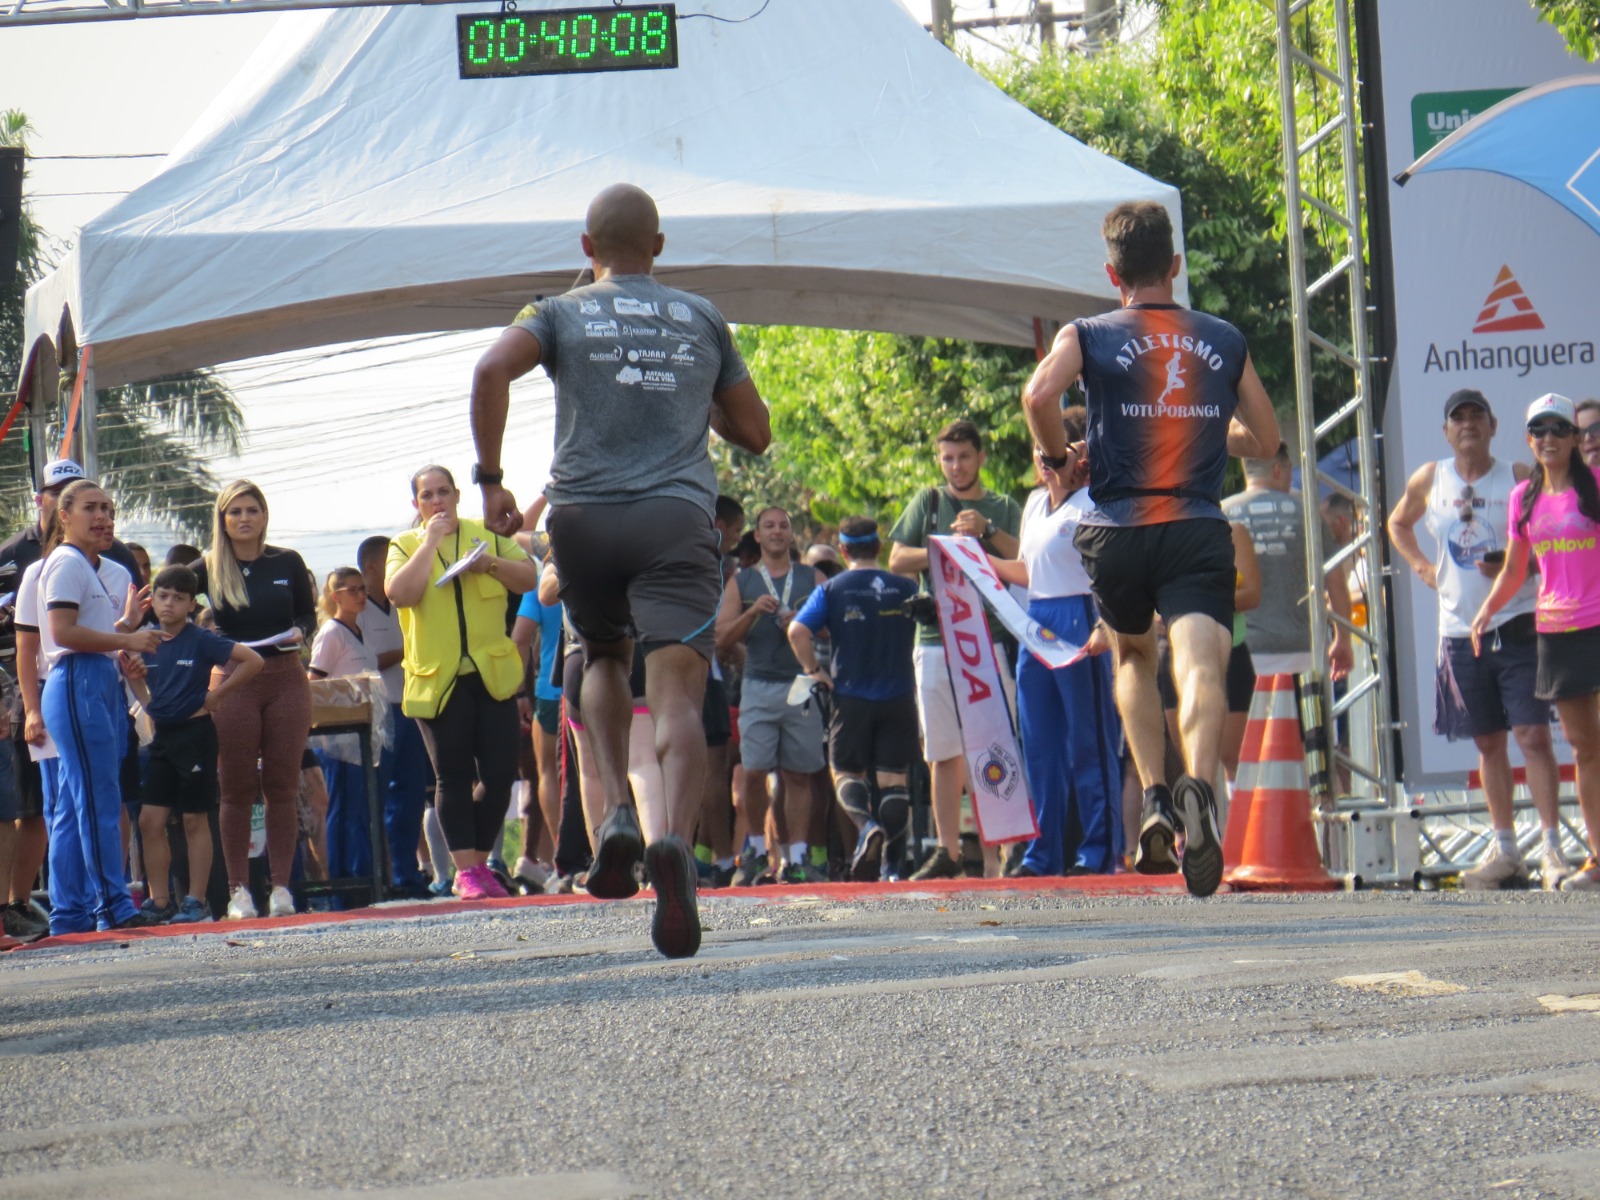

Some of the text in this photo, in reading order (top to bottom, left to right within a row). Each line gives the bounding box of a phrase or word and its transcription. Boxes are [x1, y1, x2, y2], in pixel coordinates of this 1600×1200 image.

[469, 11, 668, 64] 00:40:08
[1115, 333, 1224, 372] ATLETISMO
[1423, 339, 1595, 378] Anhanguera
[1120, 403, 1220, 418] VOTUPORANGA
